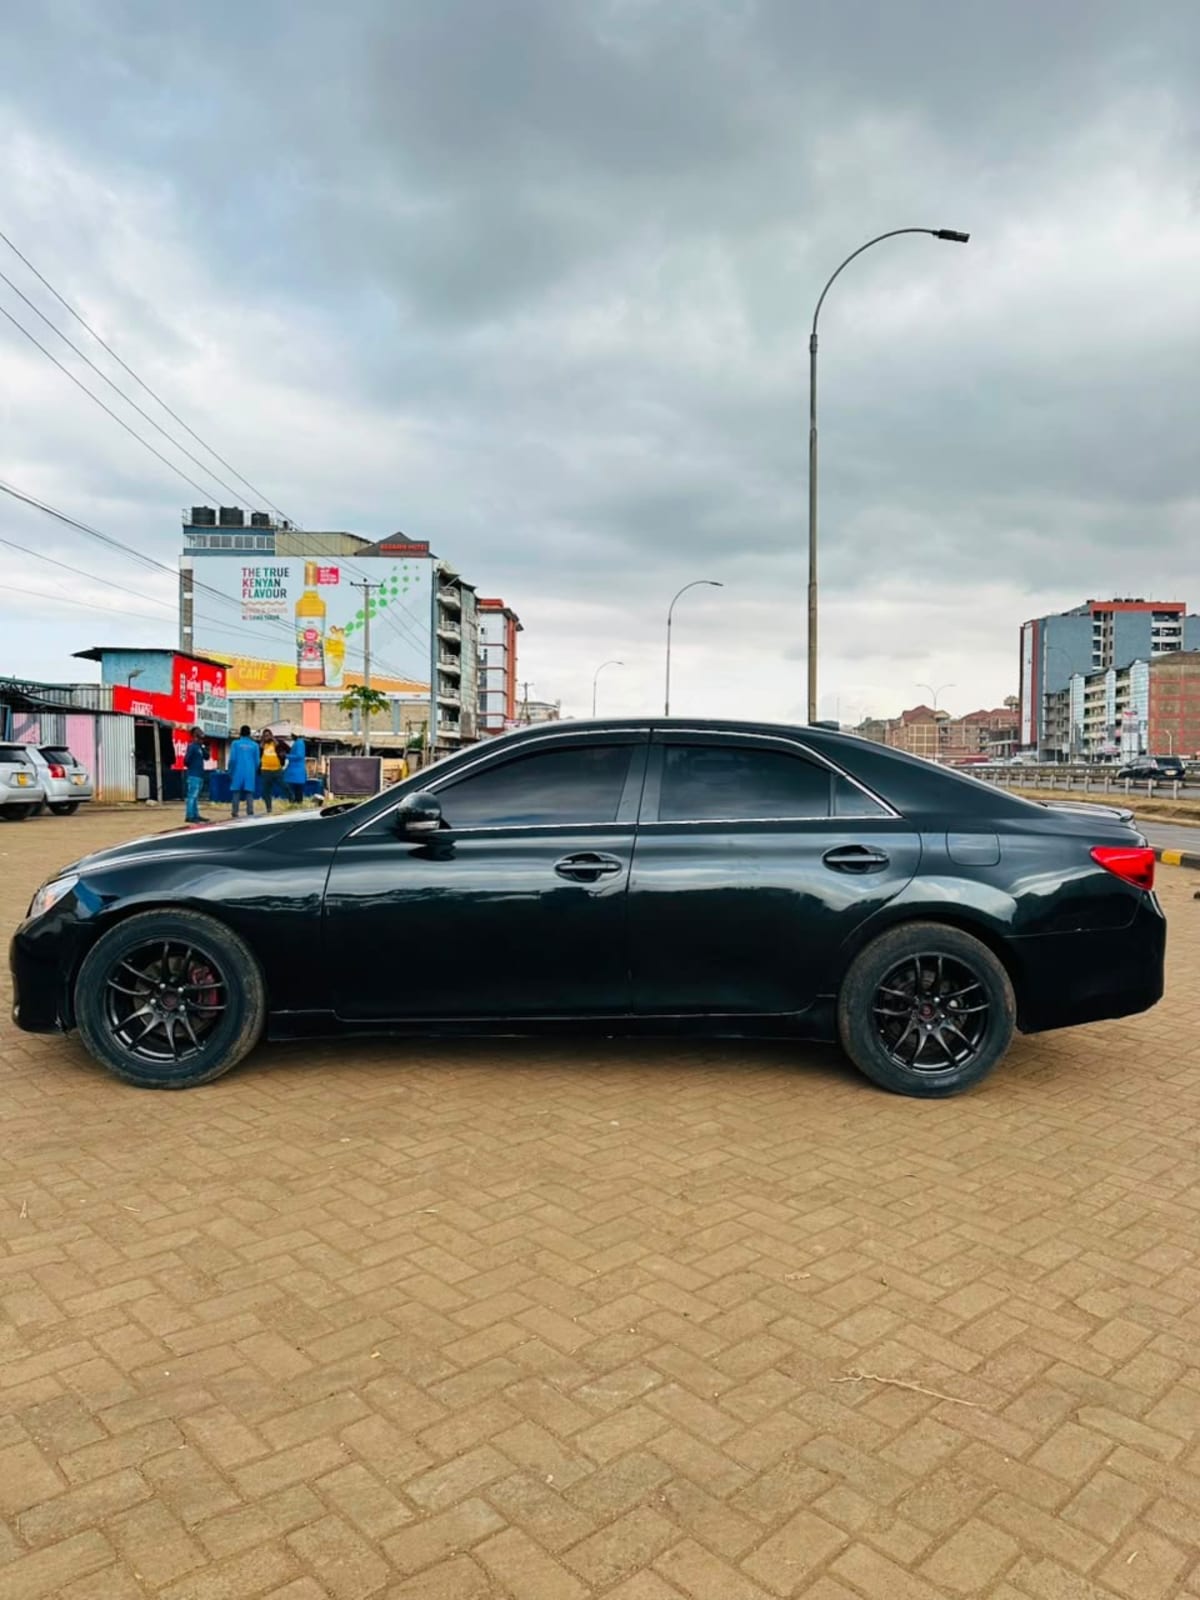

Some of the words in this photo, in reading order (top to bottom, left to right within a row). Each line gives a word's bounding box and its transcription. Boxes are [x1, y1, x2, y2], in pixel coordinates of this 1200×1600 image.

[241, 567, 261, 578] THE
[263, 567, 290, 578] TRUE
[241, 578, 281, 588] KENYAN
[241, 588, 287, 599] FLAVOUR
